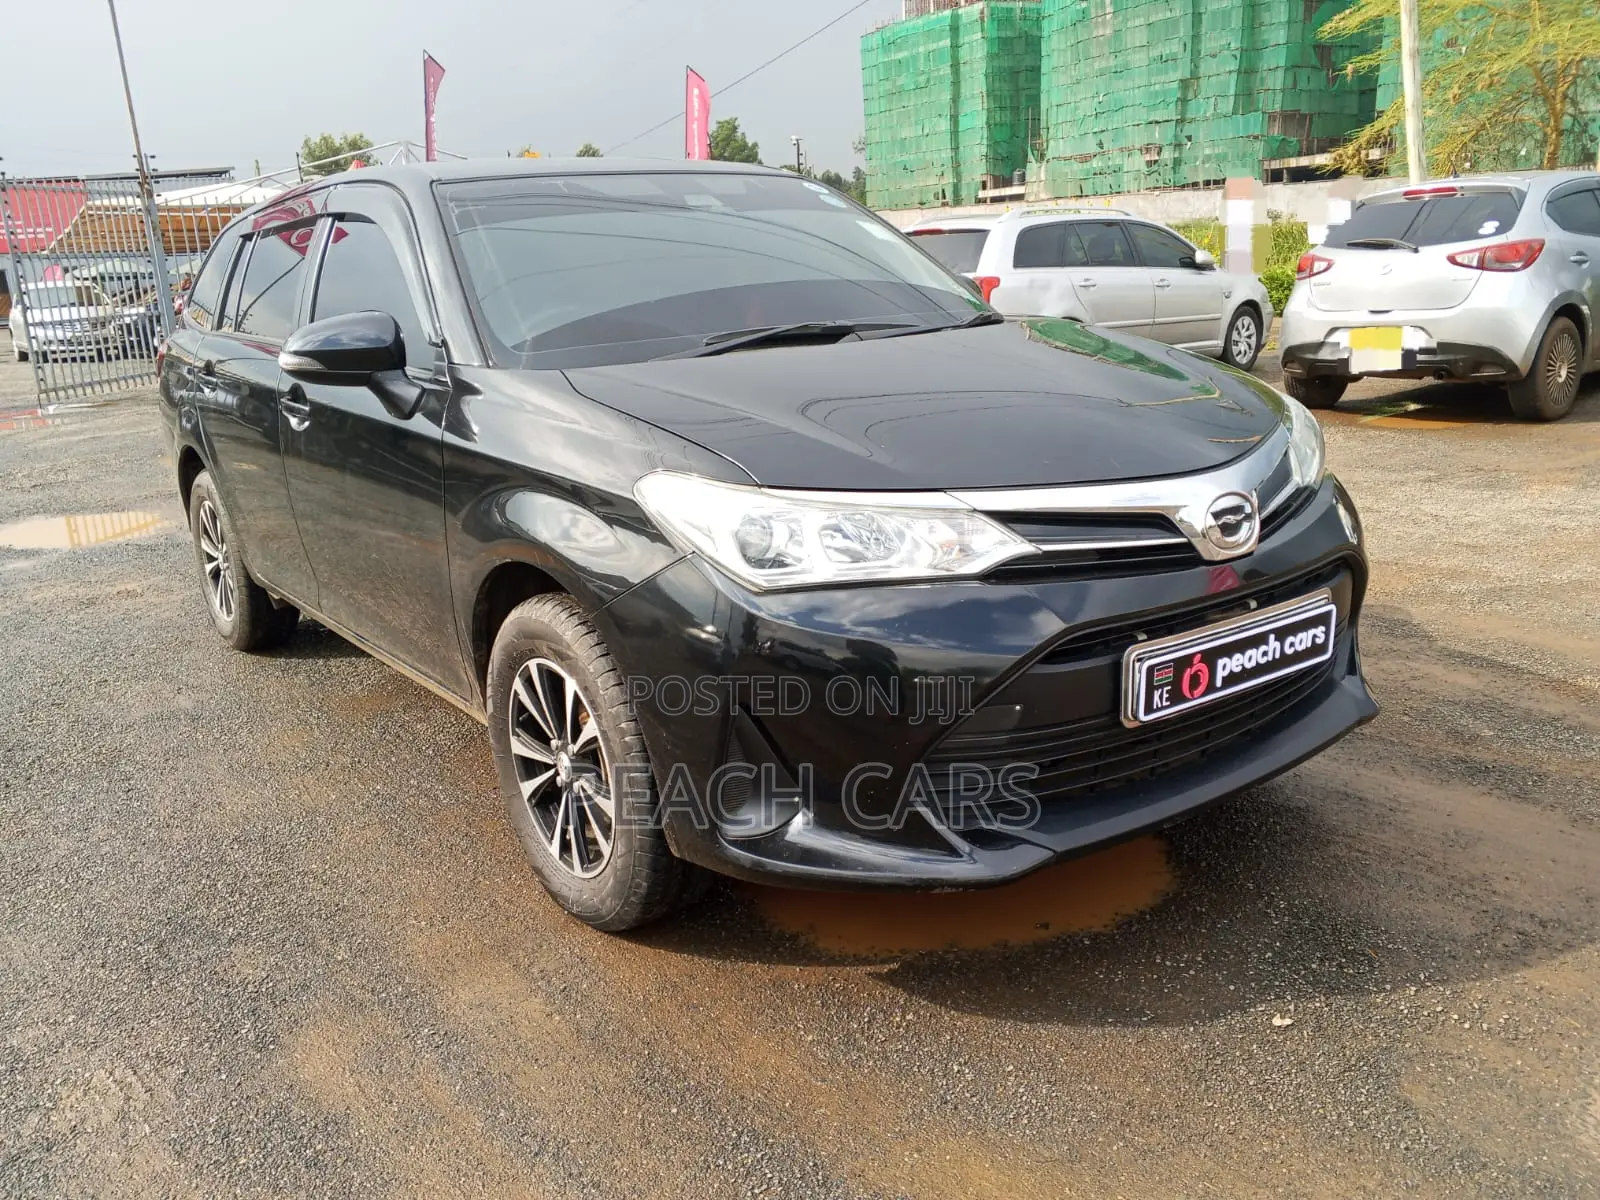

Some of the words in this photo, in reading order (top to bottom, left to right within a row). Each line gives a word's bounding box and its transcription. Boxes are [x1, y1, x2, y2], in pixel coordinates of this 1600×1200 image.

[1216, 634, 1281, 687] peach
[1285, 625, 1326, 655] cars
[1153, 685, 1172, 709] KE
